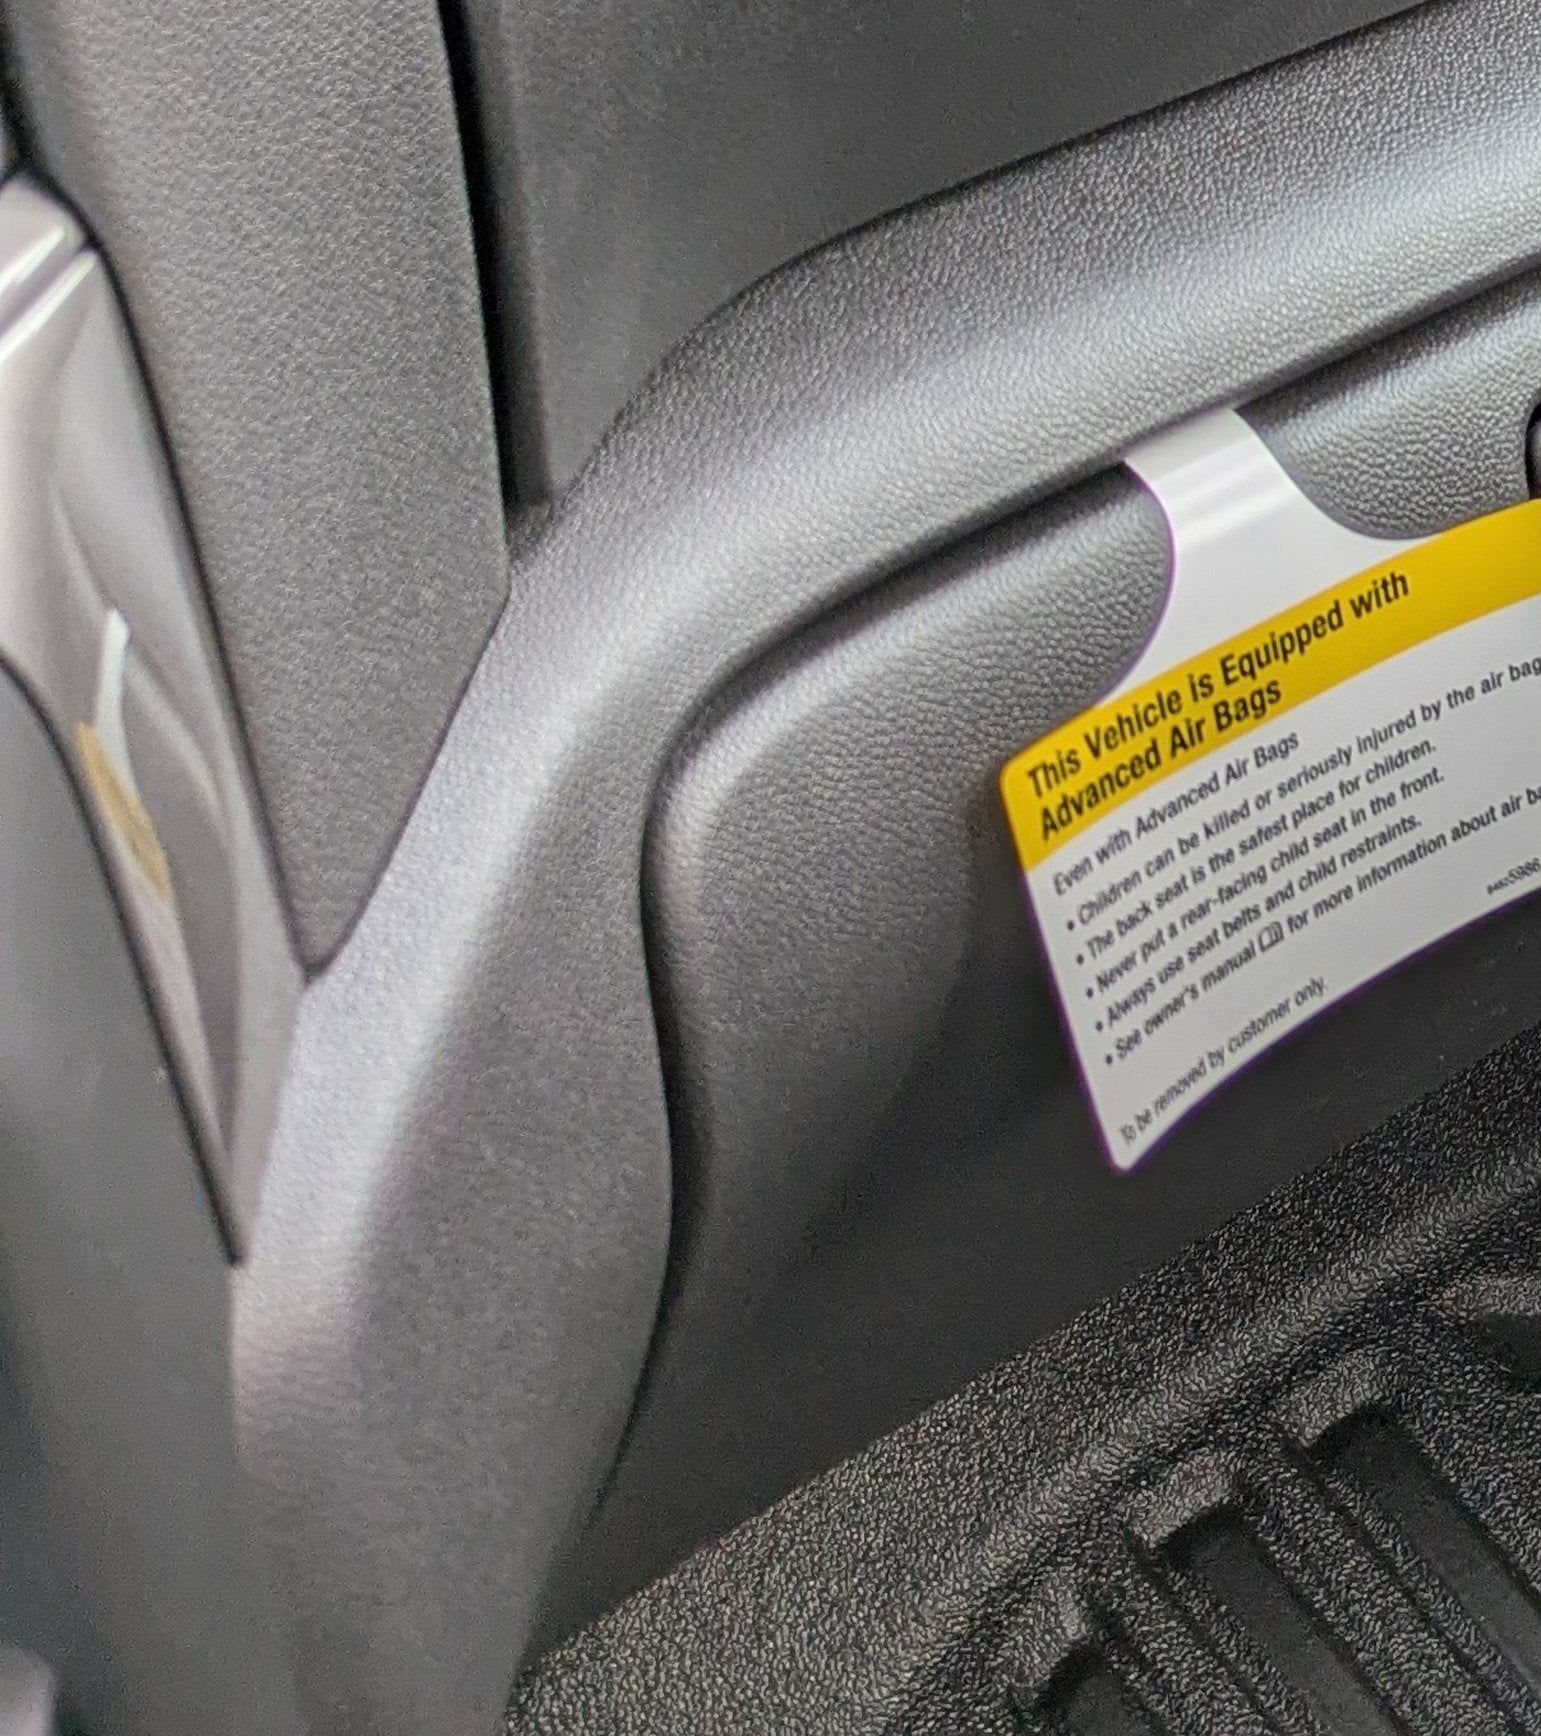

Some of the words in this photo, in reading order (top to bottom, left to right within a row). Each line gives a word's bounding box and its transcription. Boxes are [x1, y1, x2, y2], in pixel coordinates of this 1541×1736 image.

[1027, 748, 1082, 799] This
[1083, 690, 1182, 760] Vehicle
[1187, 673, 1215, 704] is
[1220, 600, 1344, 686] Equipped
[1349, 572, 1410, 620] with
[1041, 740, 1162, 841] Advanced
[1169, 717, 1207, 760] Air
[1213, 680, 1282, 733] Bags
[1053, 857, 1093, 896] Even
[1094, 828, 1132, 865] with
[1135, 771, 1220, 839] Advanced
[1225, 756, 1250, 786] Air
[1253, 732, 1299, 768] Bags
[1077, 869, 1143, 926] Children
[1144, 847, 1176, 878] can
[1177, 832, 1200, 856] be
[1203, 799, 1250, 840] killed
[1255, 788, 1273, 810] or
[1278, 744, 1352, 798] seriously
[1356, 709, 1417, 754] injured
[1420, 700, 1442, 722] by
[1446, 685, 1475, 709] the
[1481, 671, 1504, 695] air
[1086, 930, 1115, 959] The
[1116, 899, 1153, 937] back
[1155, 874, 1189, 910] seat
[1191, 865, 1206, 884] is
[1208, 848, 1236, 873] the
[1239, 814, 1289, 853] safest
[1291, 790, 1335, 830] place
[1339, 775, 1362, 800] for
[1366, 738, 1437, 785] children.
[1095, 950, 1137, 993] Never
[1140, 929, 1165, 963] put
[1168, 922, 1179, 938] a
[1179, 865, 1268, 929] rear-facing
[1270, 835, 1310, 872] child
[1312, 816, 1348, 848] seat
[1350, 807, 1367, 827] in
[1369, 790, 1397, 814] the
[1400, 766, 1444, 800] front.
[1106, 977, 1156, 1027] Always
[1157, 956, 1185, 985] use
[1187, 929, 1222, 963] seat
[1222, 904, 1262, 939] belts
[1264, 879, 1295, 913] and
[1298, 855, 1338, 891] child
[1340, 814, 1422, 868] restraints.
[1114, 1028, 1142, 1060] See
[1143, 982, 1199, 1035] owner's
[1201, 939, 1257, 991] manual
[1287, 907, 1310, 934] for
[1312, 883, 1354, 918] more
[1355, 832, 1448, 892] information
[1450, 805, 1497, 842] about
[1500, 794, 1523, 818] air
[1119, 1124, 1136, 1145] To
[1134, 1108, 1154, 1132] be
[1153, 1057, 1207, 1117] removed
[1207, 1046, 1225, 1068] by
[1226, 997, 1291, 1054] customer
[1294, 975, 1328, 1007] only.
